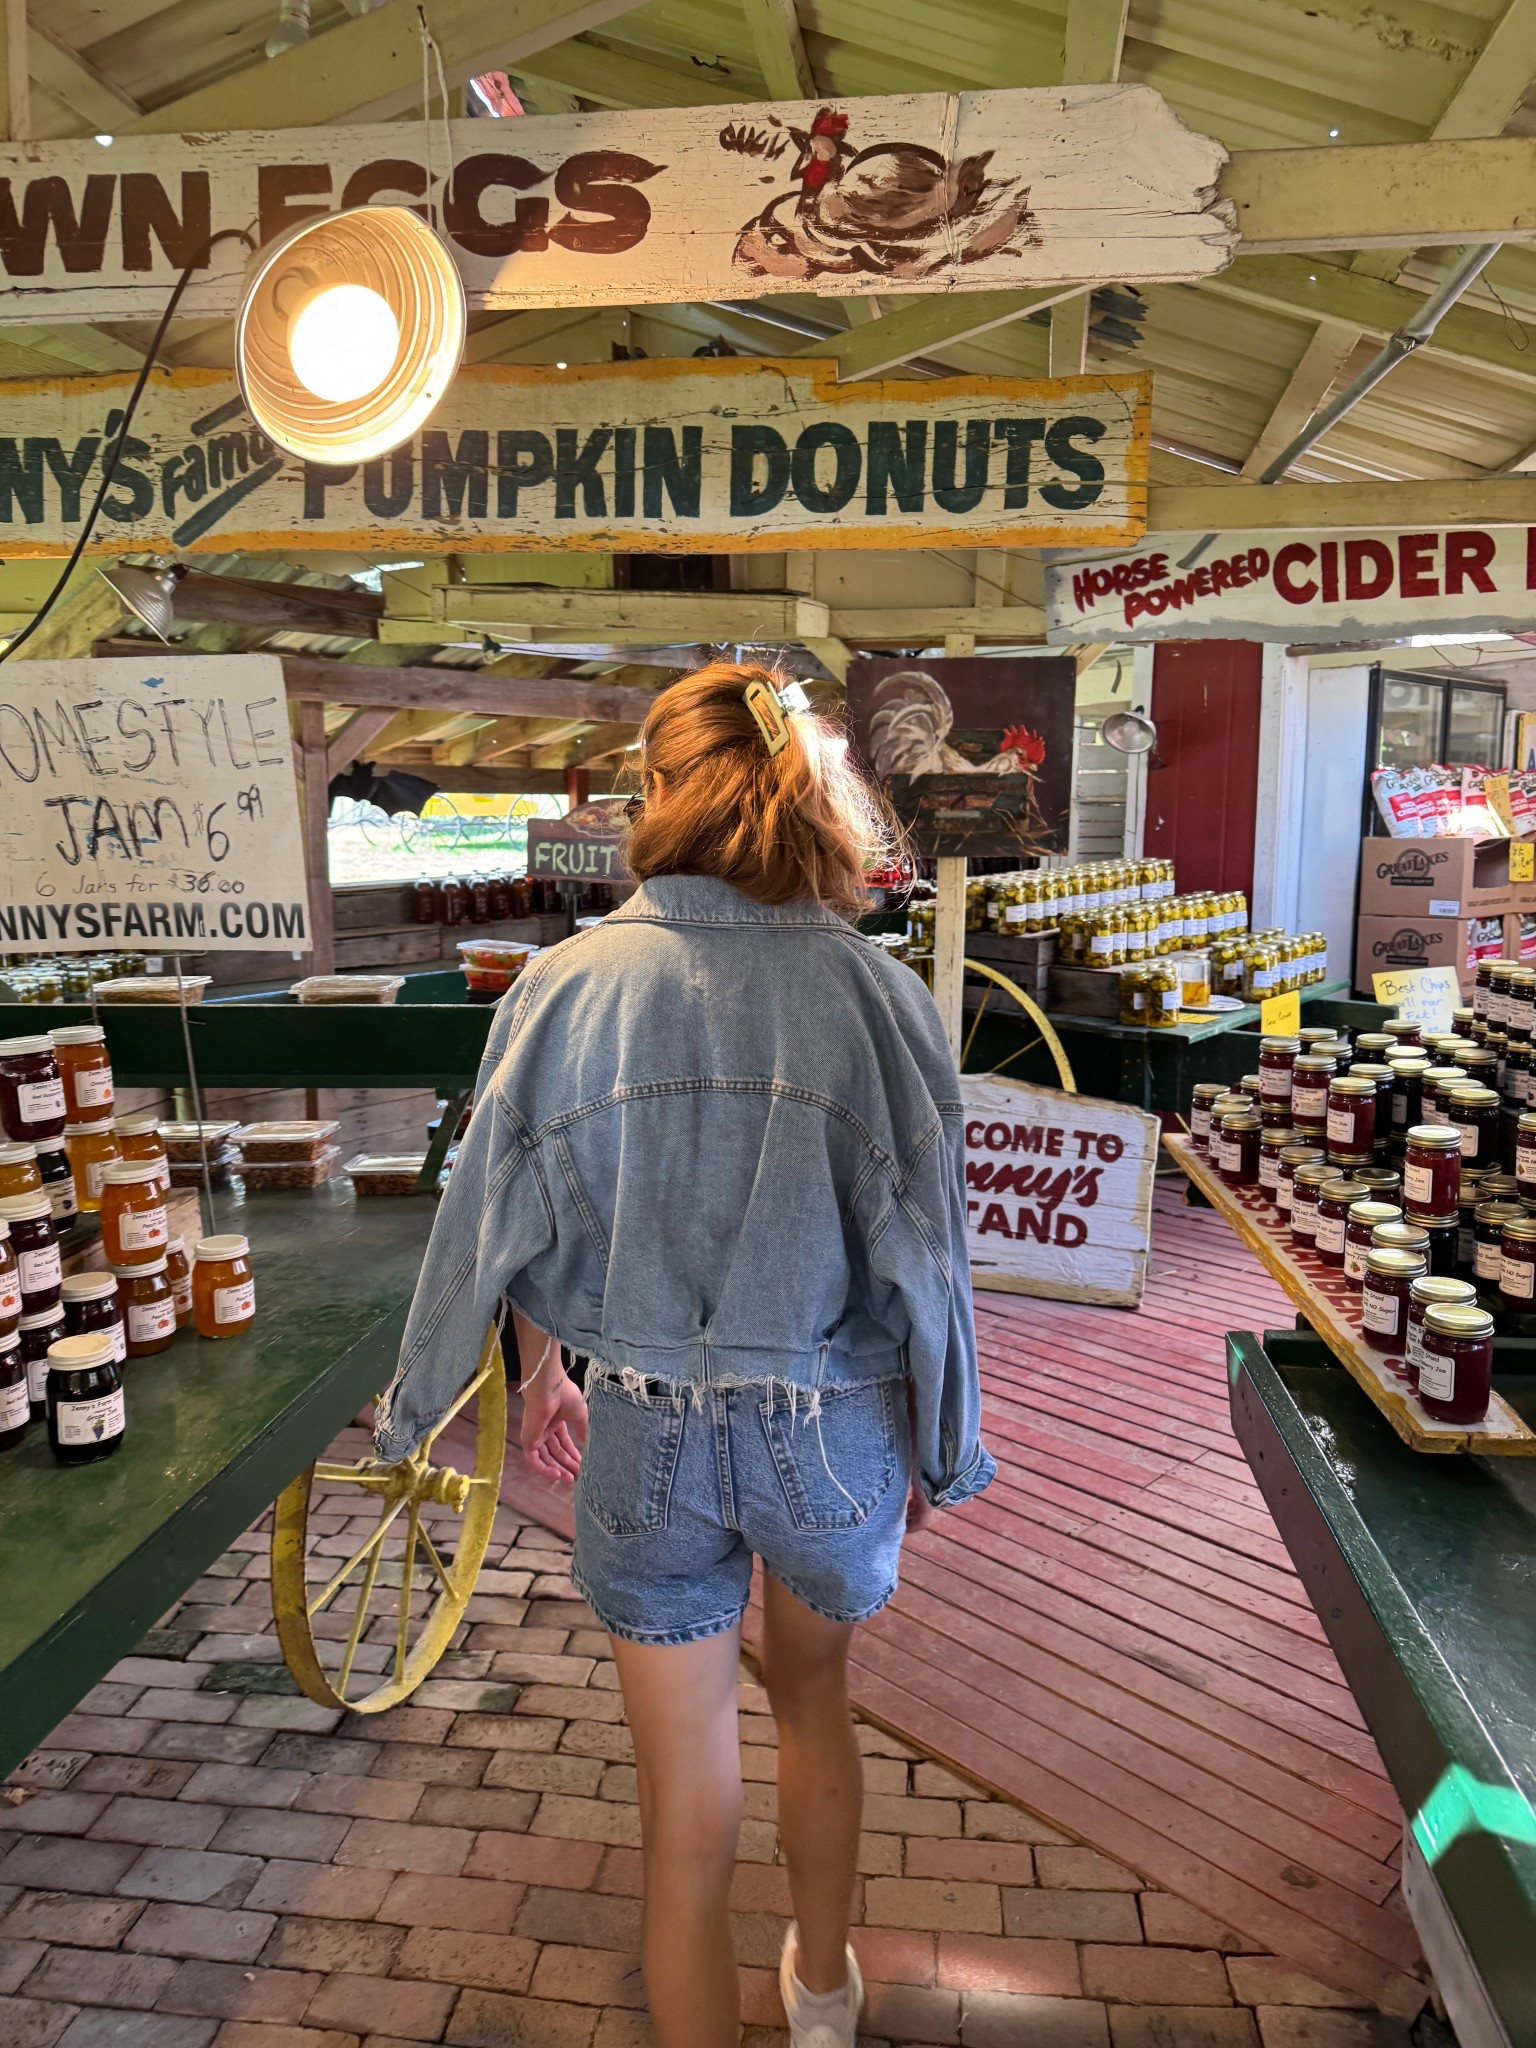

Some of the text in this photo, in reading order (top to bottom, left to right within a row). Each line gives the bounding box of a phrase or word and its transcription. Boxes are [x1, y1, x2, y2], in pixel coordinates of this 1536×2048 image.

[0, 170, 211, 276] WN
[303, 424, 703, 520] PUMPKIN
[730, 415, 1107, 517] DONUTS
[1072, 552, 1171, 614] HORSE
[1273, 530, 1500, 605] CIDER
[1123, 547, 1270, 629] POWERED
[43, 795, 191, 866] JAM
[535, 842, 618, 875] FRUIT
[36, 871, 56, 897] 6
[72, 874, 117, 894] Jars
[125, 873, 159, 893] for
[1380, 976, 1451, 996] Best Chips
[965, 1120, 1125, 1163] COME TO
[1378, 1306, 1397, 1314] Sugar
